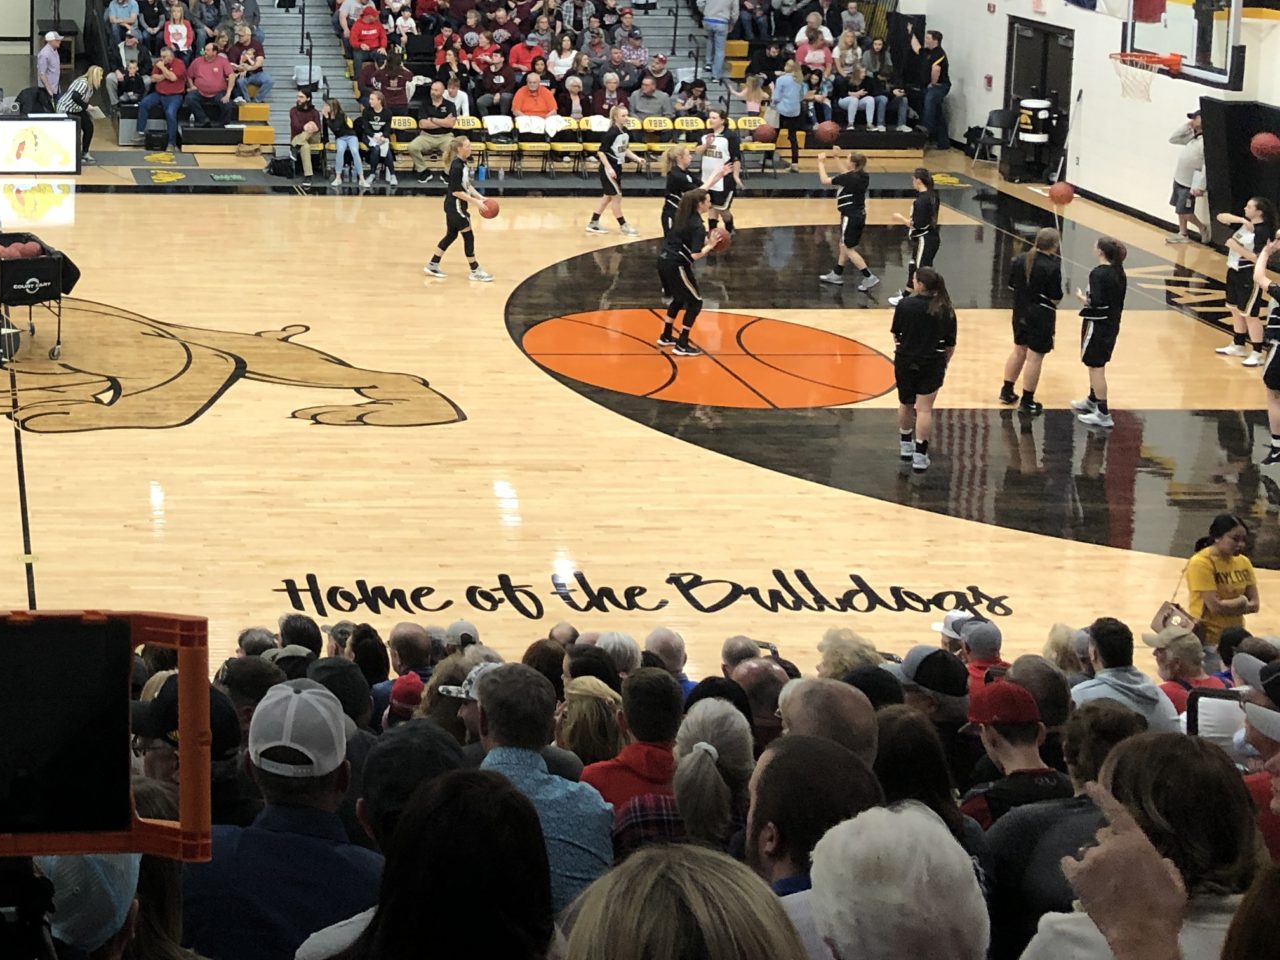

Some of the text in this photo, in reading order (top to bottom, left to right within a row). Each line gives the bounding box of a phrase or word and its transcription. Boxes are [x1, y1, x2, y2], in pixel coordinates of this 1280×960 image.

[392, 118, 412, 127] VBBS
[456, 115, 476, 127] VBBS
[648, 117, 668, 128] VBBS
[680, 117, 699, 128] VBBS
[742, 117, 761, 128] VBBS
[1214, 568, 1250, 585] AYLOR
[272, 567, 1015, 619] Home of the Bulldogs
